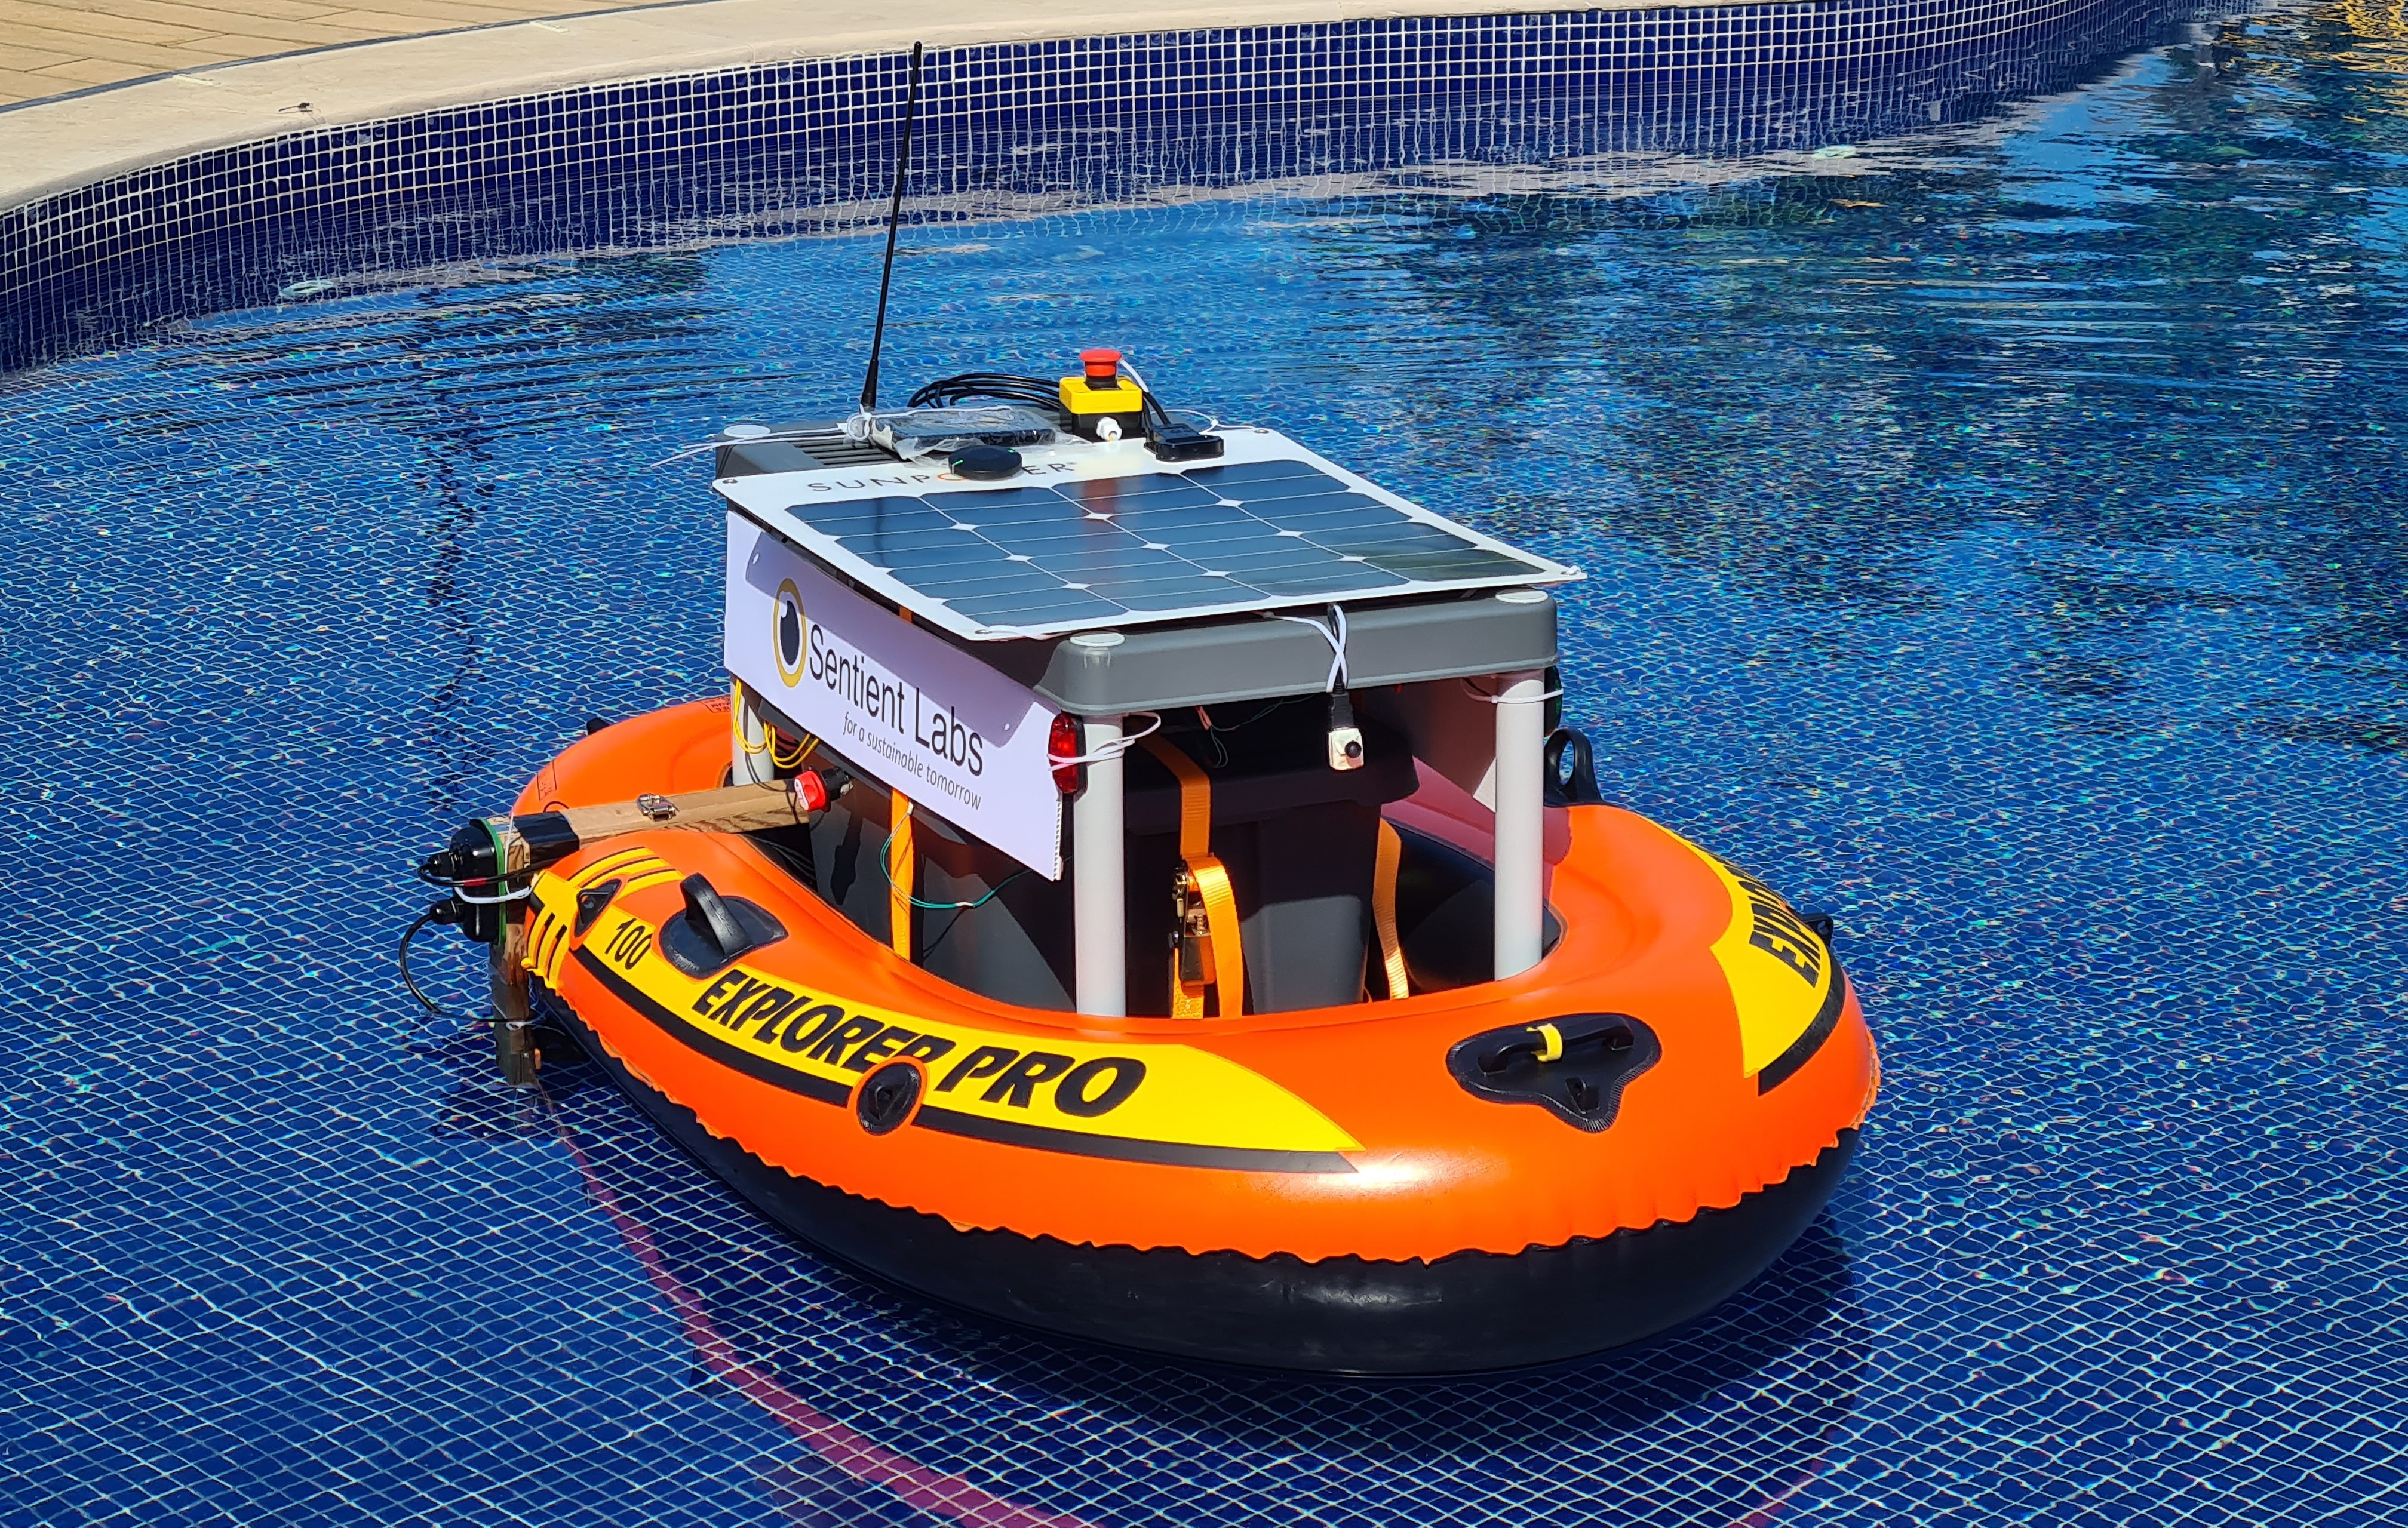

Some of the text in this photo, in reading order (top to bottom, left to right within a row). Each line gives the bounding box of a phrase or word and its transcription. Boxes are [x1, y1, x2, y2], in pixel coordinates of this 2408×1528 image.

[807, 463, 1075, 491] SUNPOER
[809, 624, 983, 776] Sentient Labs
[843, 712, 981, 810] for a sustainable tomorrow
[604, 918, 653, 970] 100
[933, 1046, 1147, 1118] PRO
